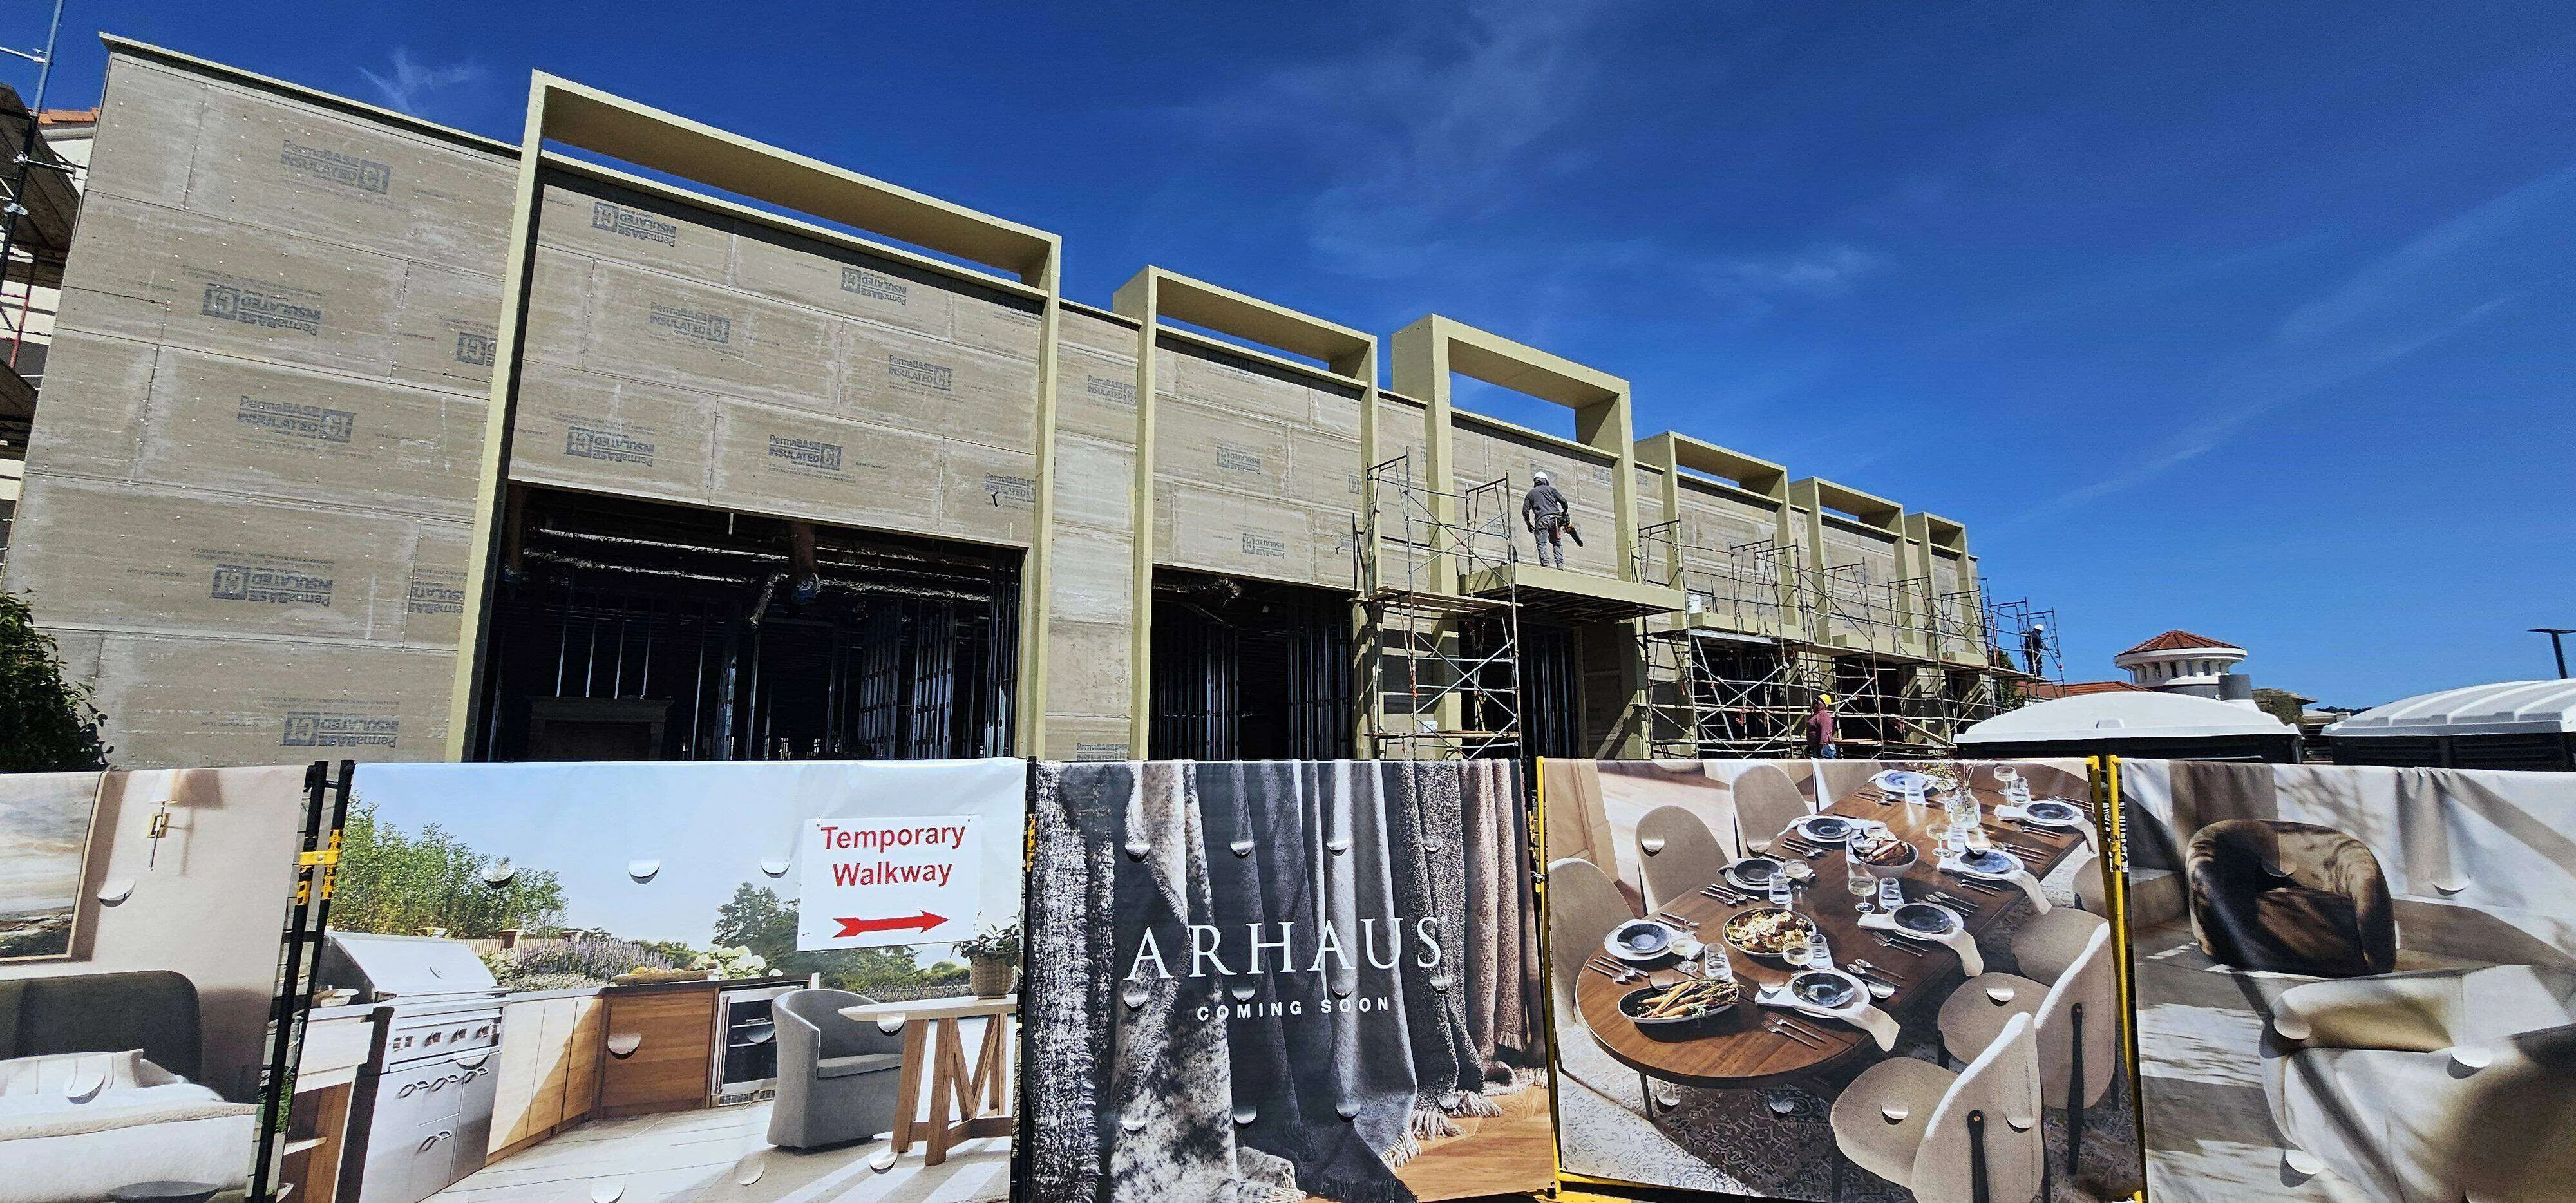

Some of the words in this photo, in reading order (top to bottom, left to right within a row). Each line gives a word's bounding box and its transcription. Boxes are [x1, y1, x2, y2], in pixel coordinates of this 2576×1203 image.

[618, 226, 676, 247] PermaBASE
[860, 287, 907, 306] PermaBASE
[650, 301, 706, 321] PermaBASE
[889, 354, 934, 372] PermaBASE
[889, 366, 933, 383] INSULATED
[769, 434, 820, 451] PermaBASE
[592, 450, 653, 467] PermaBASE
[768, 446, 820, 463] INSULATED
[1255, 539, 1285, 549] INSULATED
[249, 589, 330, 607] PermaBASE
[317, 735, 397, 748] PermaBASE
[820, 826, 966, 853] Temporary
[833, 861, 953, 887] Walkway
[1122, 916, 1443, 981] ARHAUS
[1197, 1000, 1302, 1021] COMING
[1321, 996, 1389, 1014] SOON
